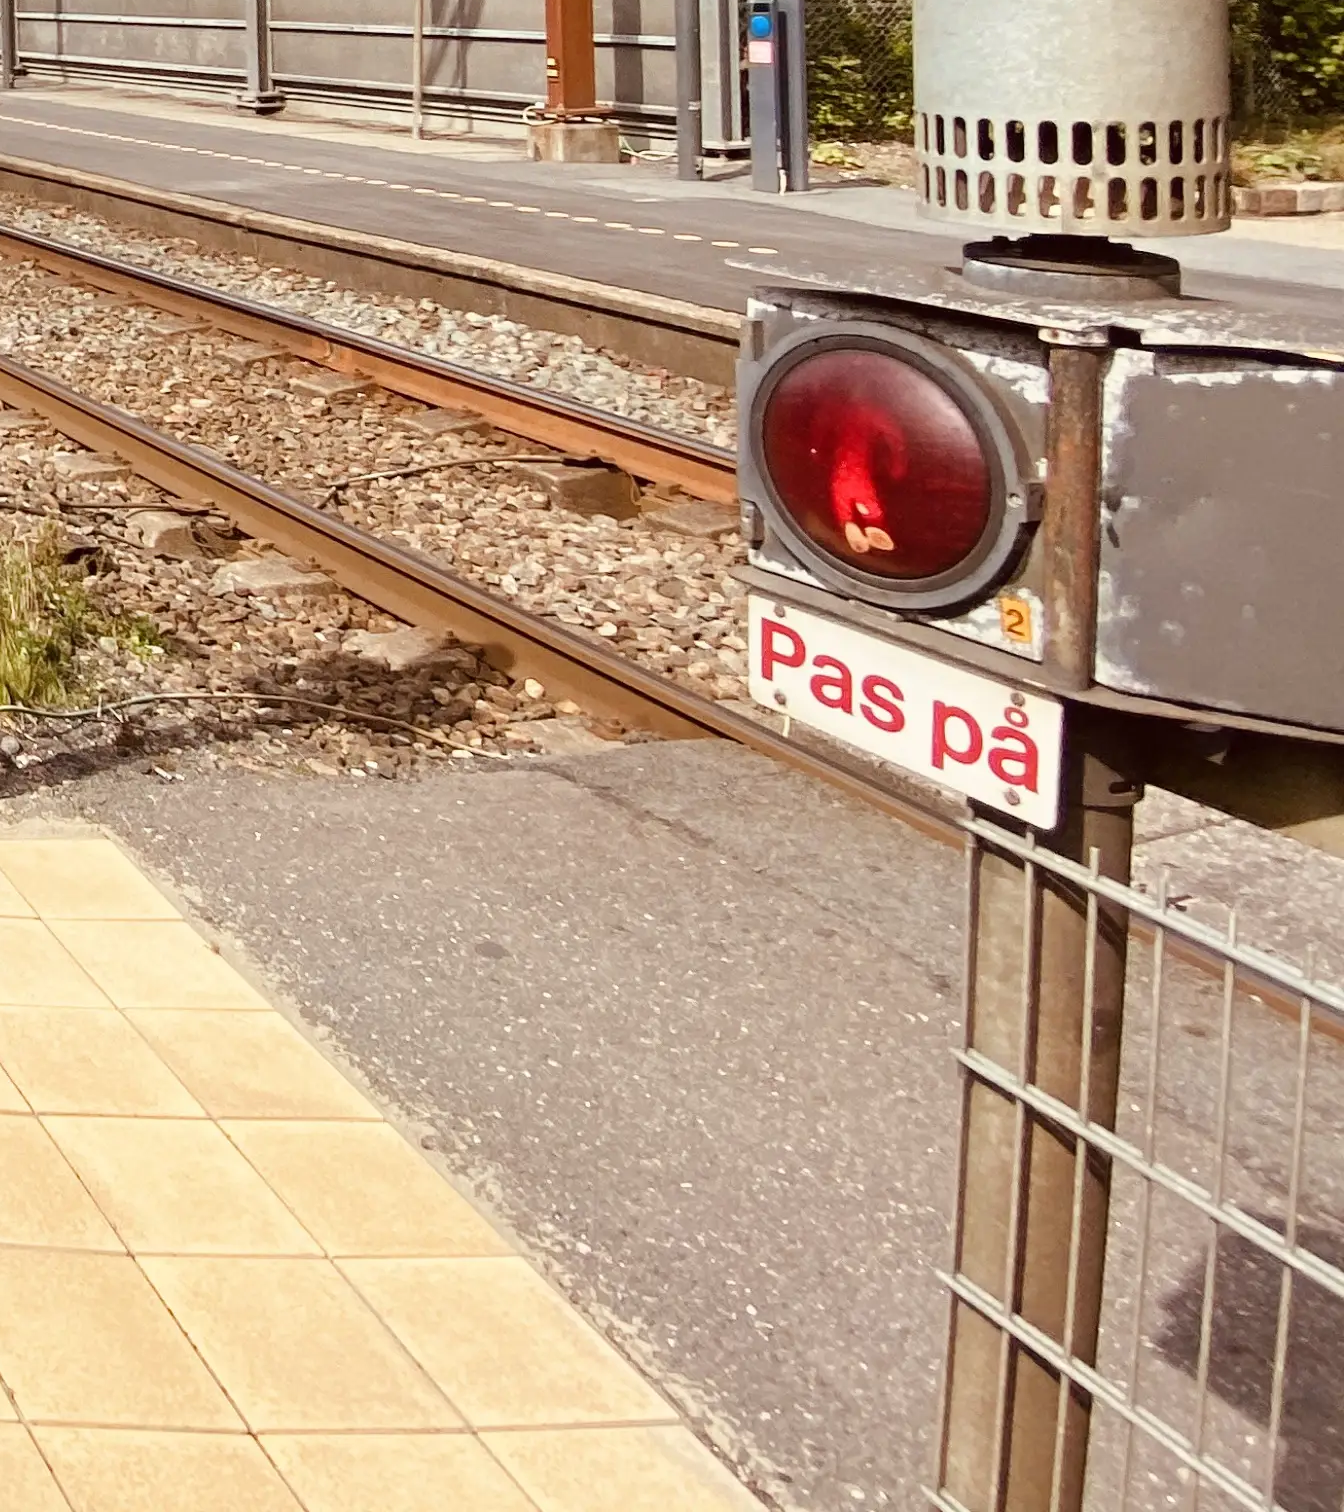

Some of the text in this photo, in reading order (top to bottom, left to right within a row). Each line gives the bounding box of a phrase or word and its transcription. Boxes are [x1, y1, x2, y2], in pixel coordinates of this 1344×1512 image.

[1005, 608, 1026, 637] 2
[760, 616, 1040, 795] Pas på
